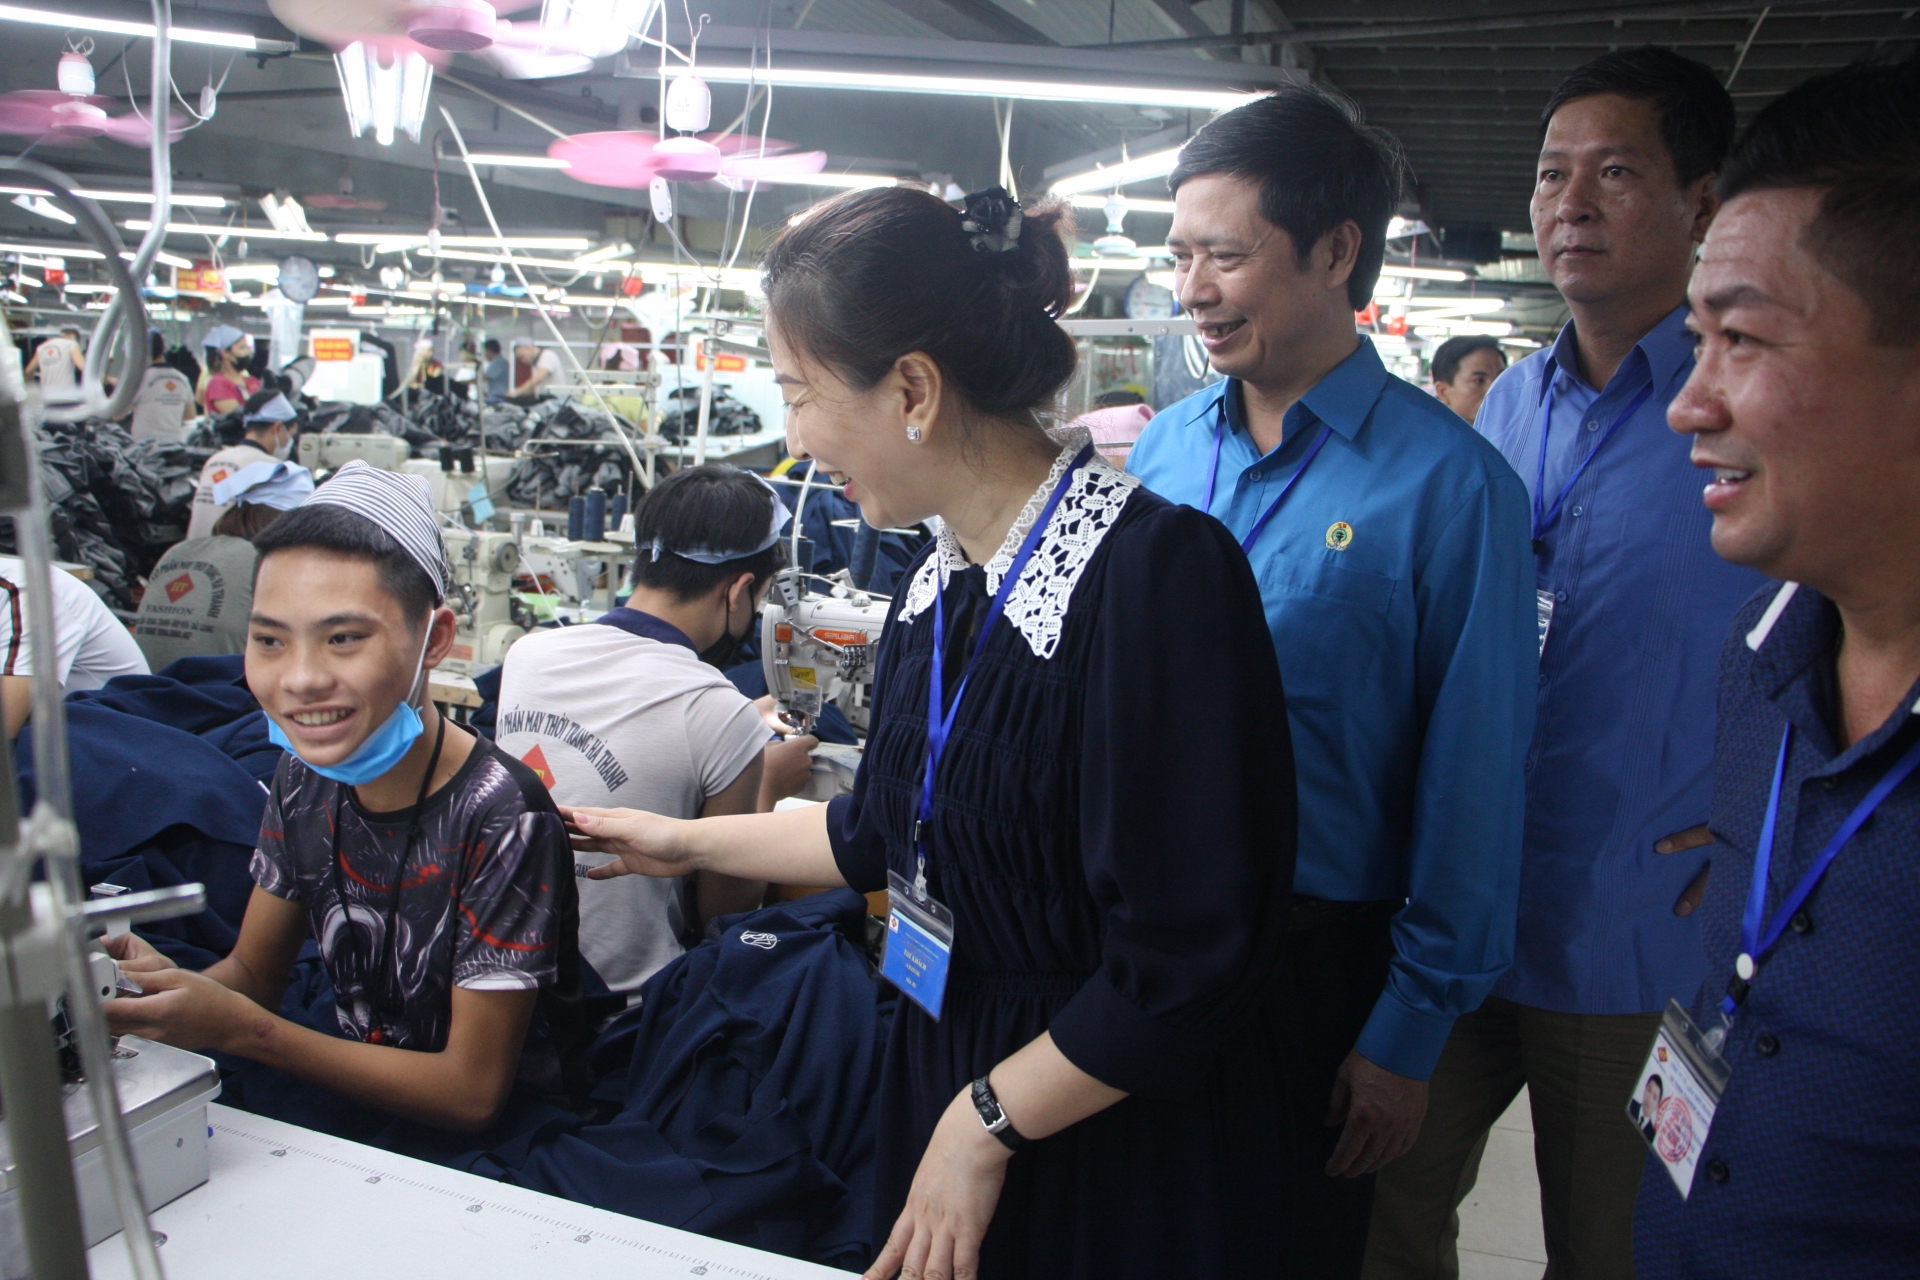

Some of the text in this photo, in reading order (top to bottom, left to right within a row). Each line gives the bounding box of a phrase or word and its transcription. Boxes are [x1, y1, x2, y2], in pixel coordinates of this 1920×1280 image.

[146, 604, 195, 616] FASHION
[824, 632, 855, 641] SIRUBA
[524, 710, 547, 733] MAY
[563, 721, 595, 753] TRANG
[594, 749, 629, 793] THANH
